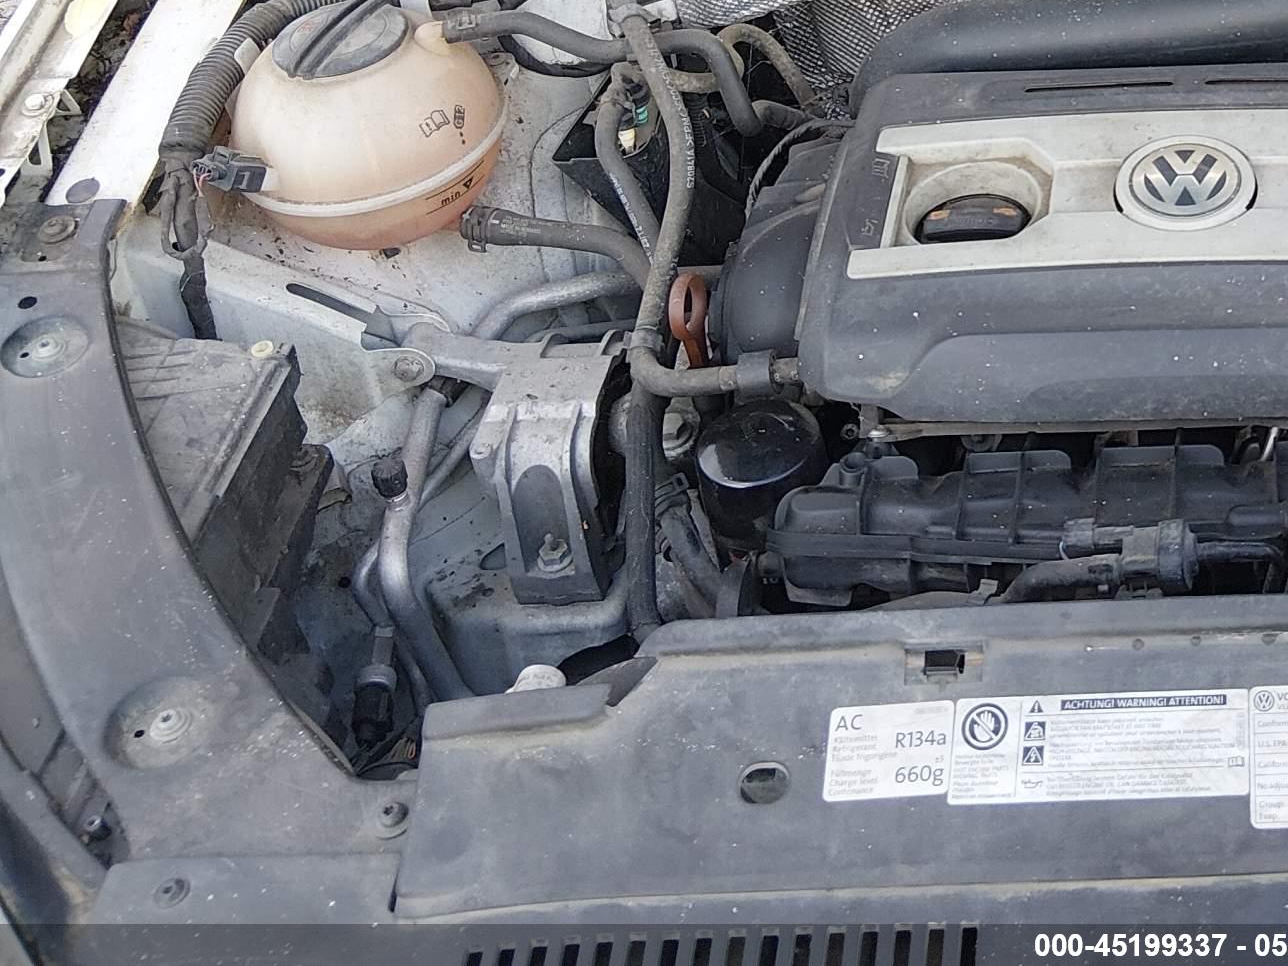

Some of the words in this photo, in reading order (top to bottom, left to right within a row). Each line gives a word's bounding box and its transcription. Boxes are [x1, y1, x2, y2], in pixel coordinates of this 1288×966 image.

[441, 191, 461, 206] min
[1064, 698, 1115, 711] ACHTUNG!
[1117, 696, 1167, 709] WARNING!
[1168, 694, 1224, 707] ATTENTION!
[834, 714, 863, 732] AC
[895, 730, 947, 748] R134a
[895, 765, 945, 786] 660g
